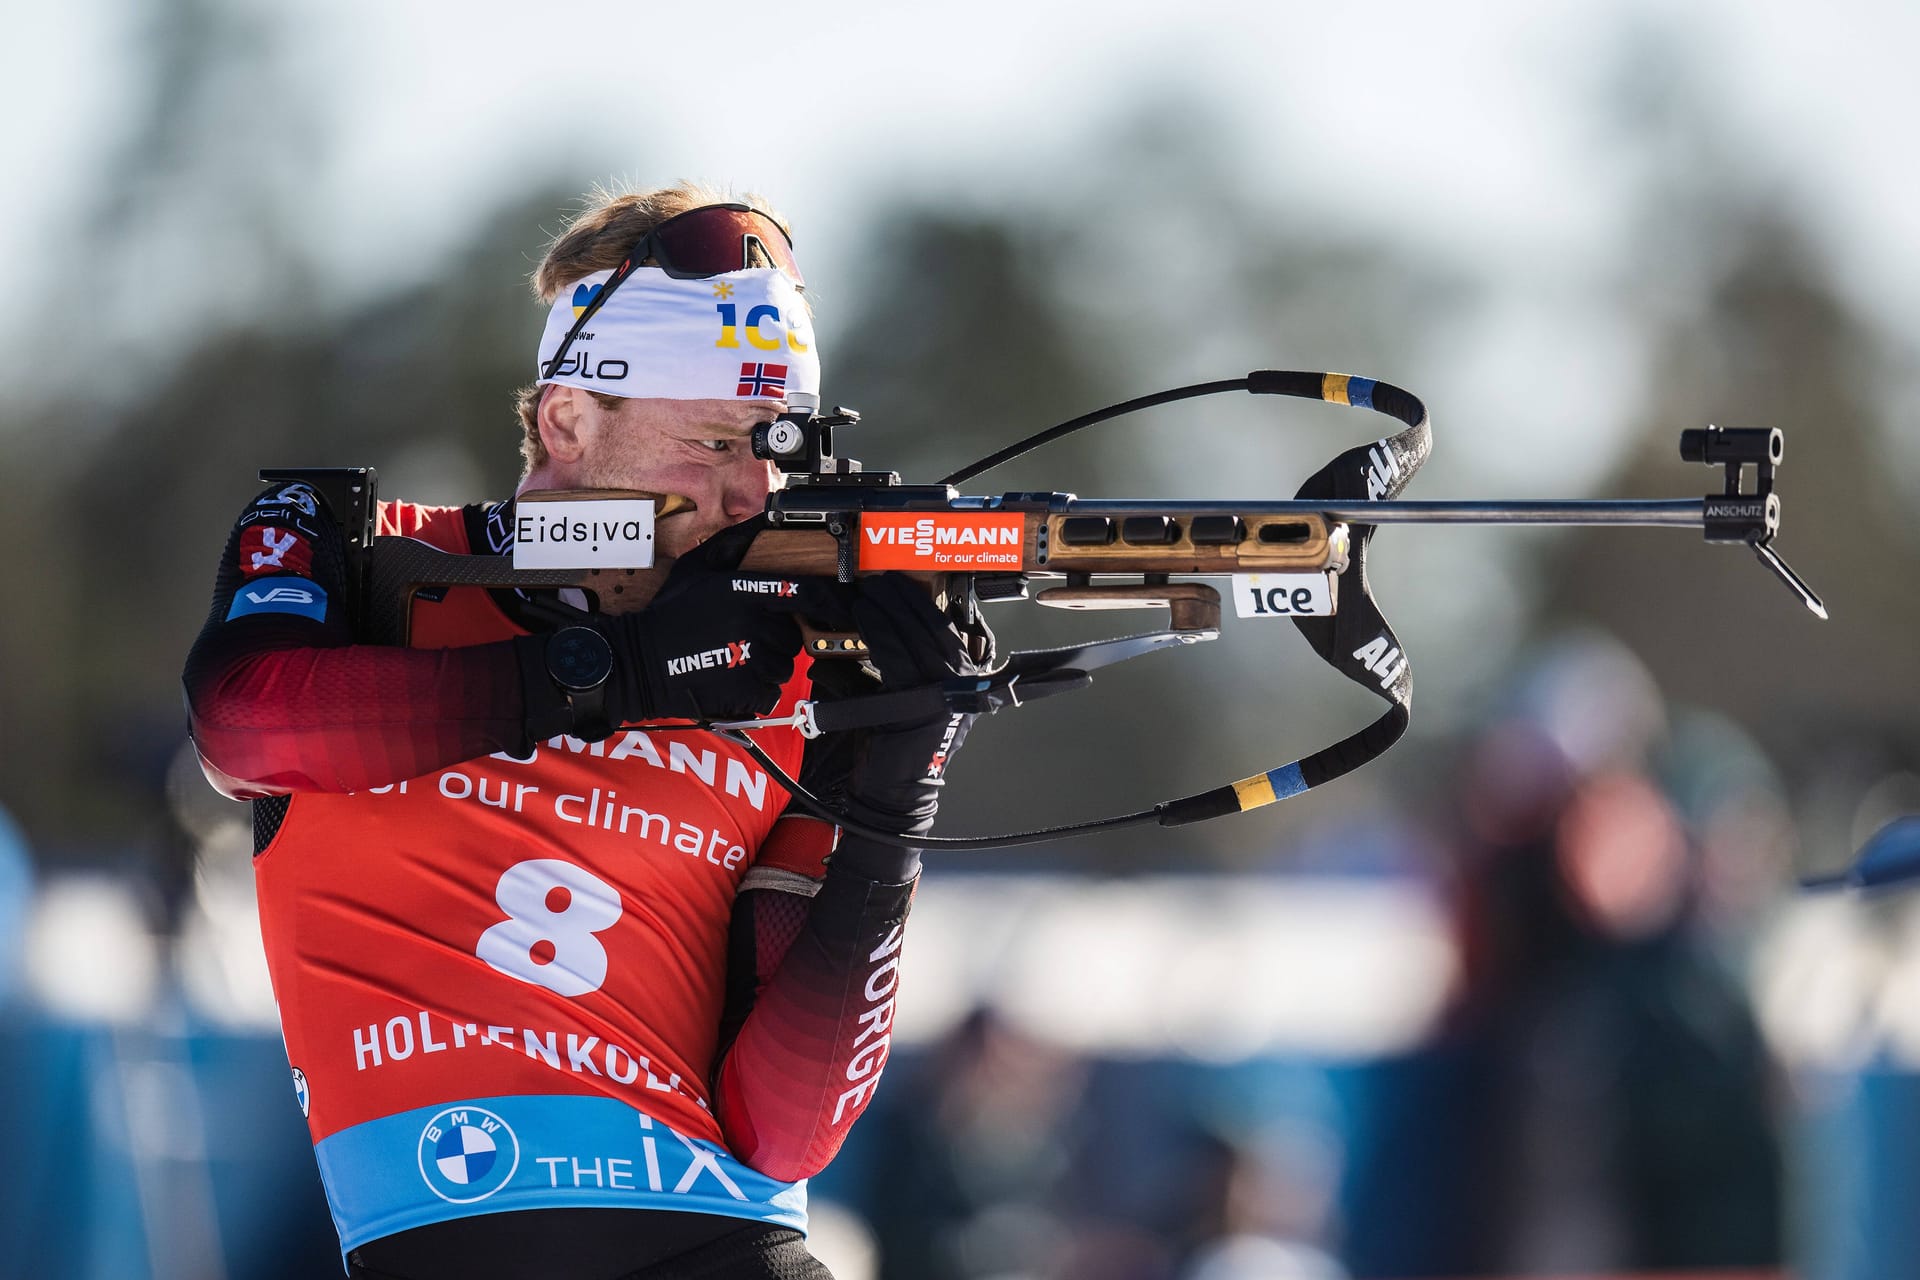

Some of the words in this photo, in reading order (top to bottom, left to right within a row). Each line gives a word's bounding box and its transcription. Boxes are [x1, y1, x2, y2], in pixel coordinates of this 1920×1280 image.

[865, 519, 1019, 556] VIESSMANN
[935, 552, 953, 563] for
[954, 554, 975, 563] our
[976, 552, 1018, 563] climate
[1250, 577, 1315, 614] ice
[439, 772, 539, 813] our
[554, 787, 746, 871] climate
[475, 858, 623, 998] 8
[426, 1111, 501, 1144] BMW
[536, 1157, 636, 1190] THE
